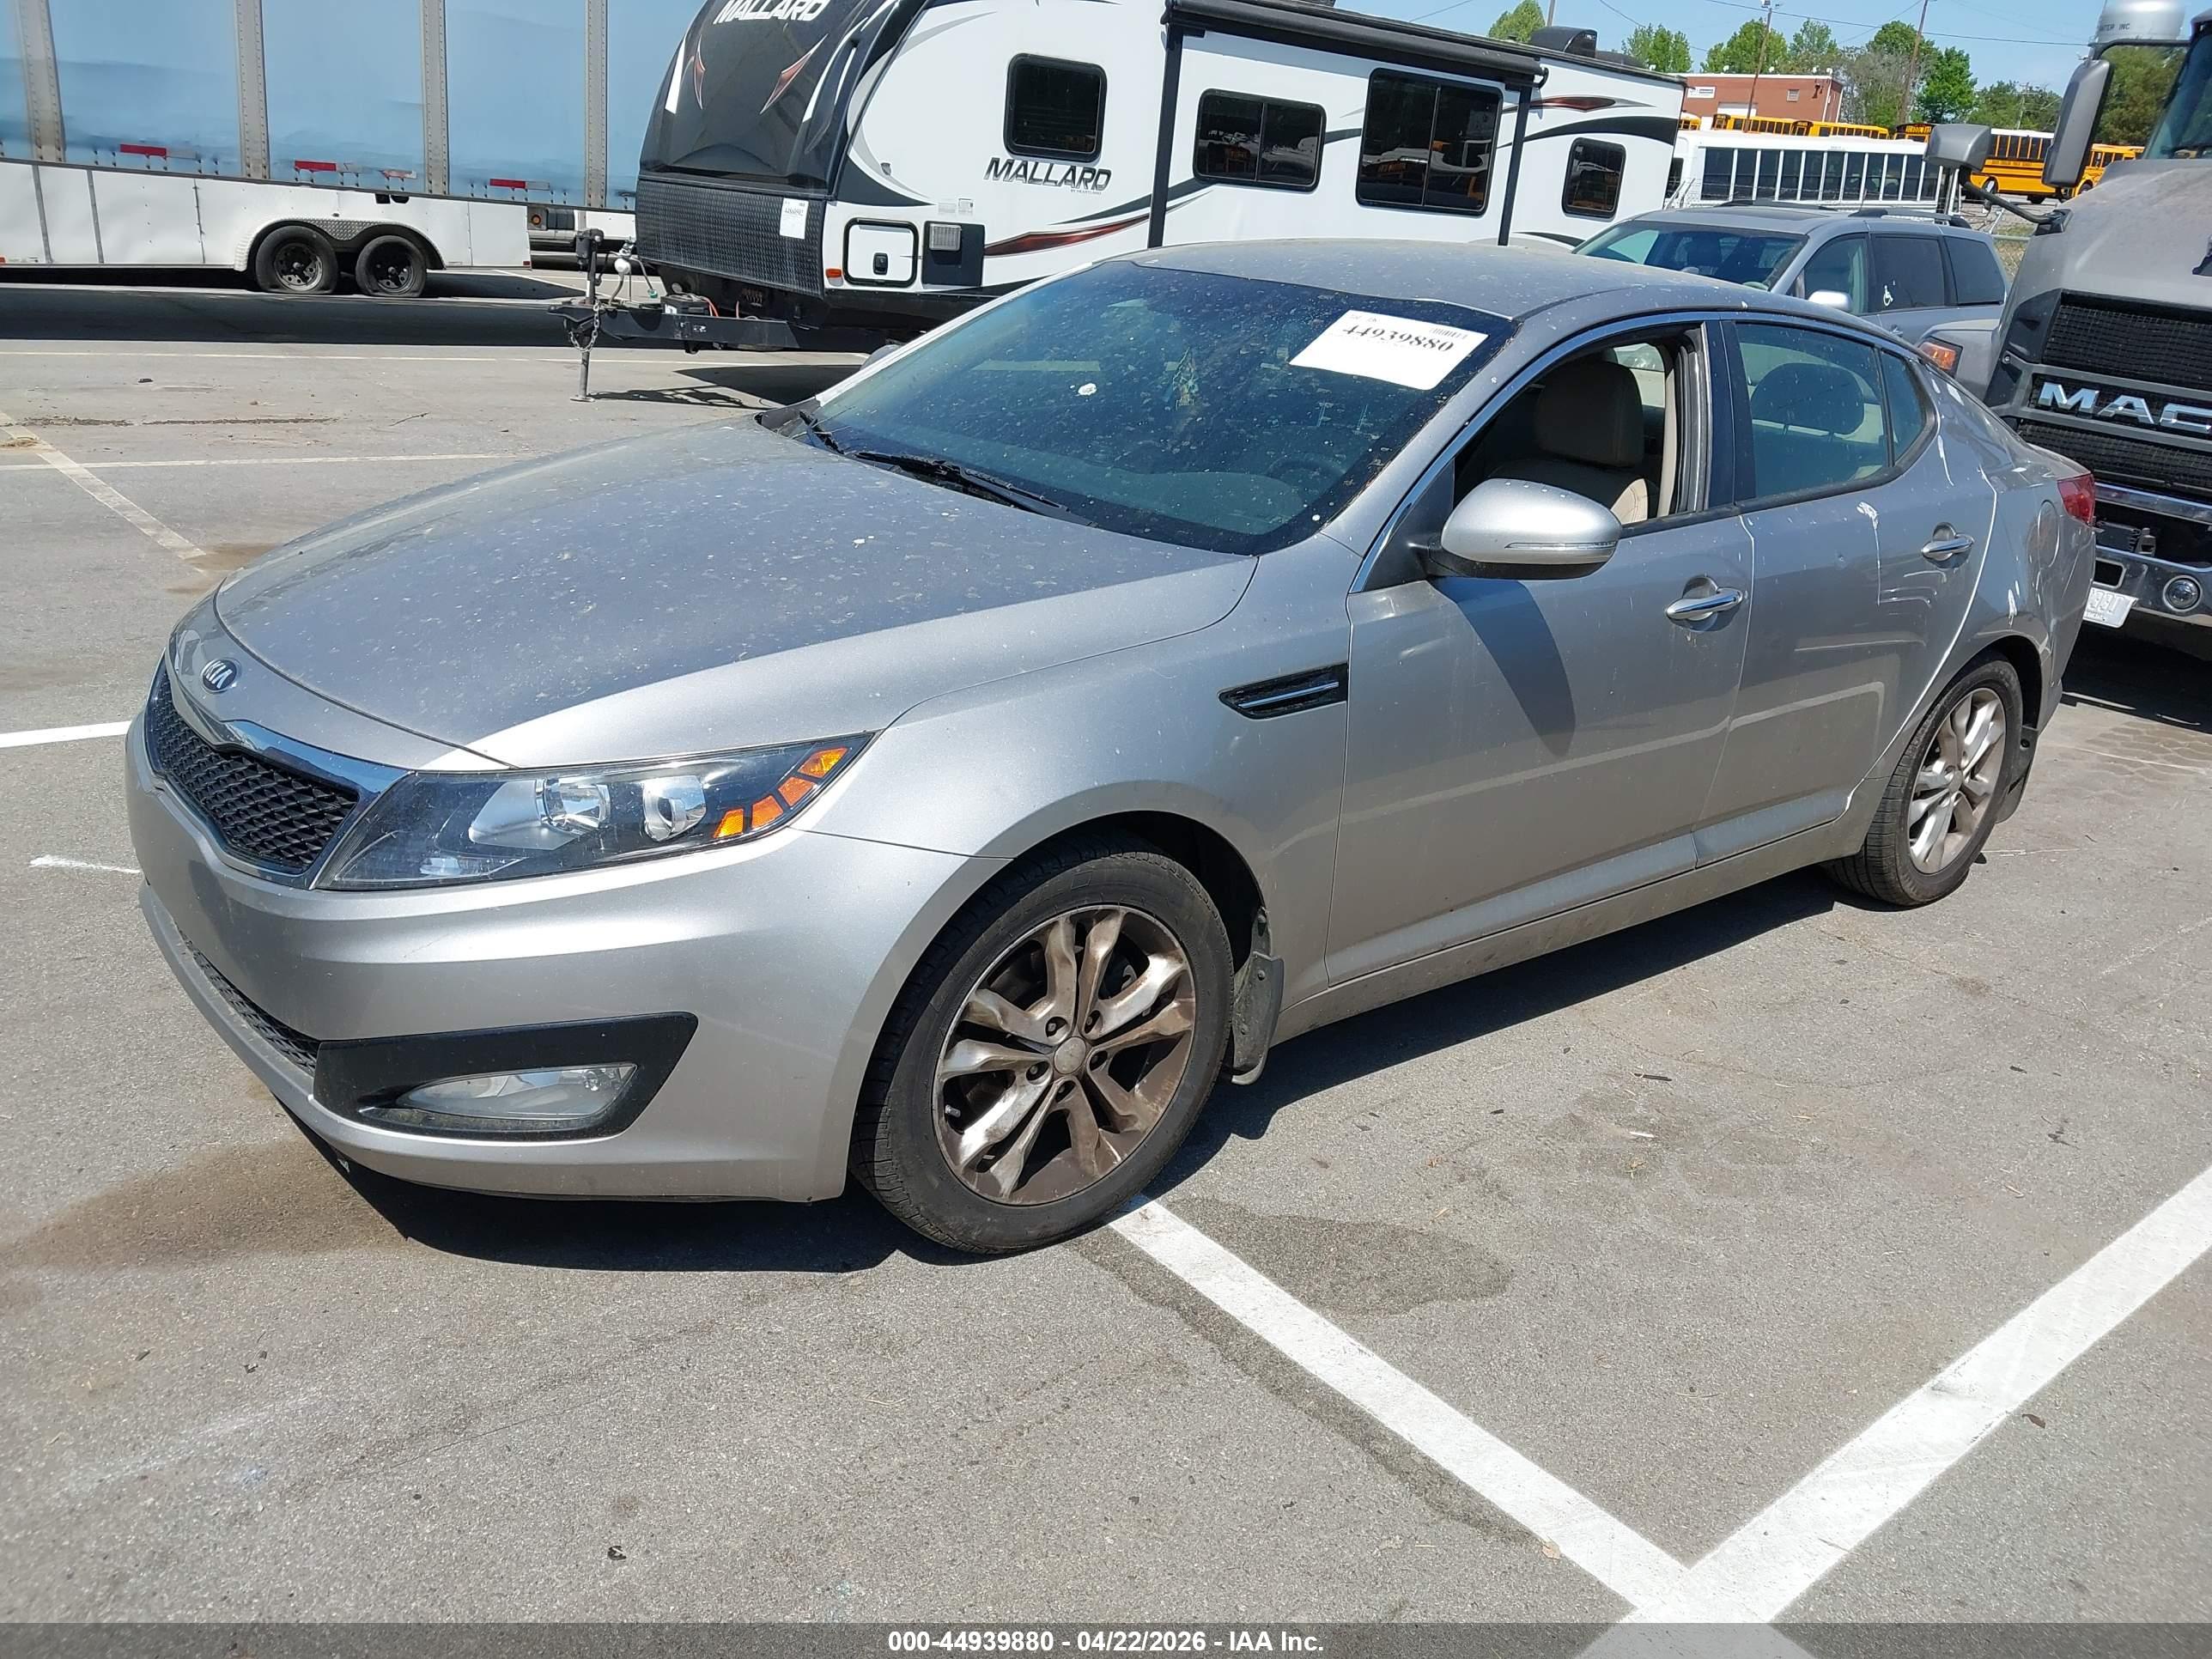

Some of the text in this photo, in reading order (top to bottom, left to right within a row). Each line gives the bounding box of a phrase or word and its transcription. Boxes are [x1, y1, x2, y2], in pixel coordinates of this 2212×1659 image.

[712, 0, 830, 24] MALLARD
[983, 156, 1112, 191] MALLARD
[1342, 325, 1455, 352] 44939880
